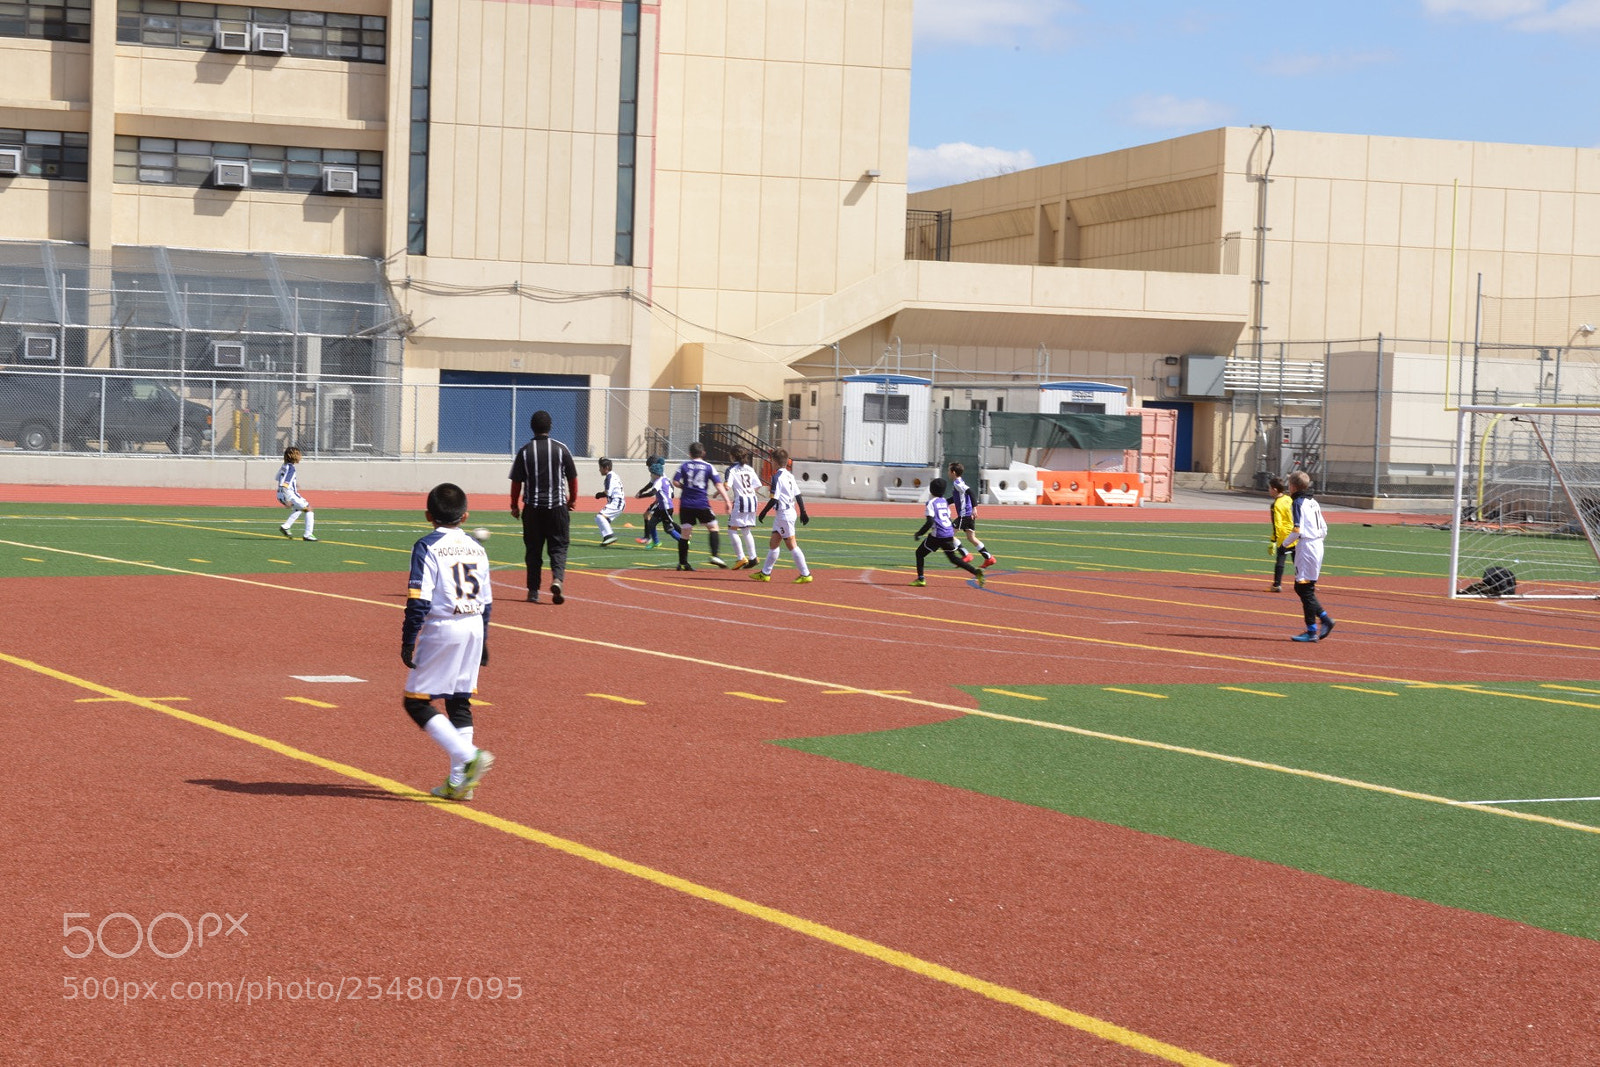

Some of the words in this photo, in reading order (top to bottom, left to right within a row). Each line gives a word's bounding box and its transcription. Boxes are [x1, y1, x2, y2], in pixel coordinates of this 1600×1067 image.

[687, 470, 706, 489] 14
[740, 473, 751, 488] 13
[938, 509, 952, 527] 5
[451, 562, 479, 599] 15
